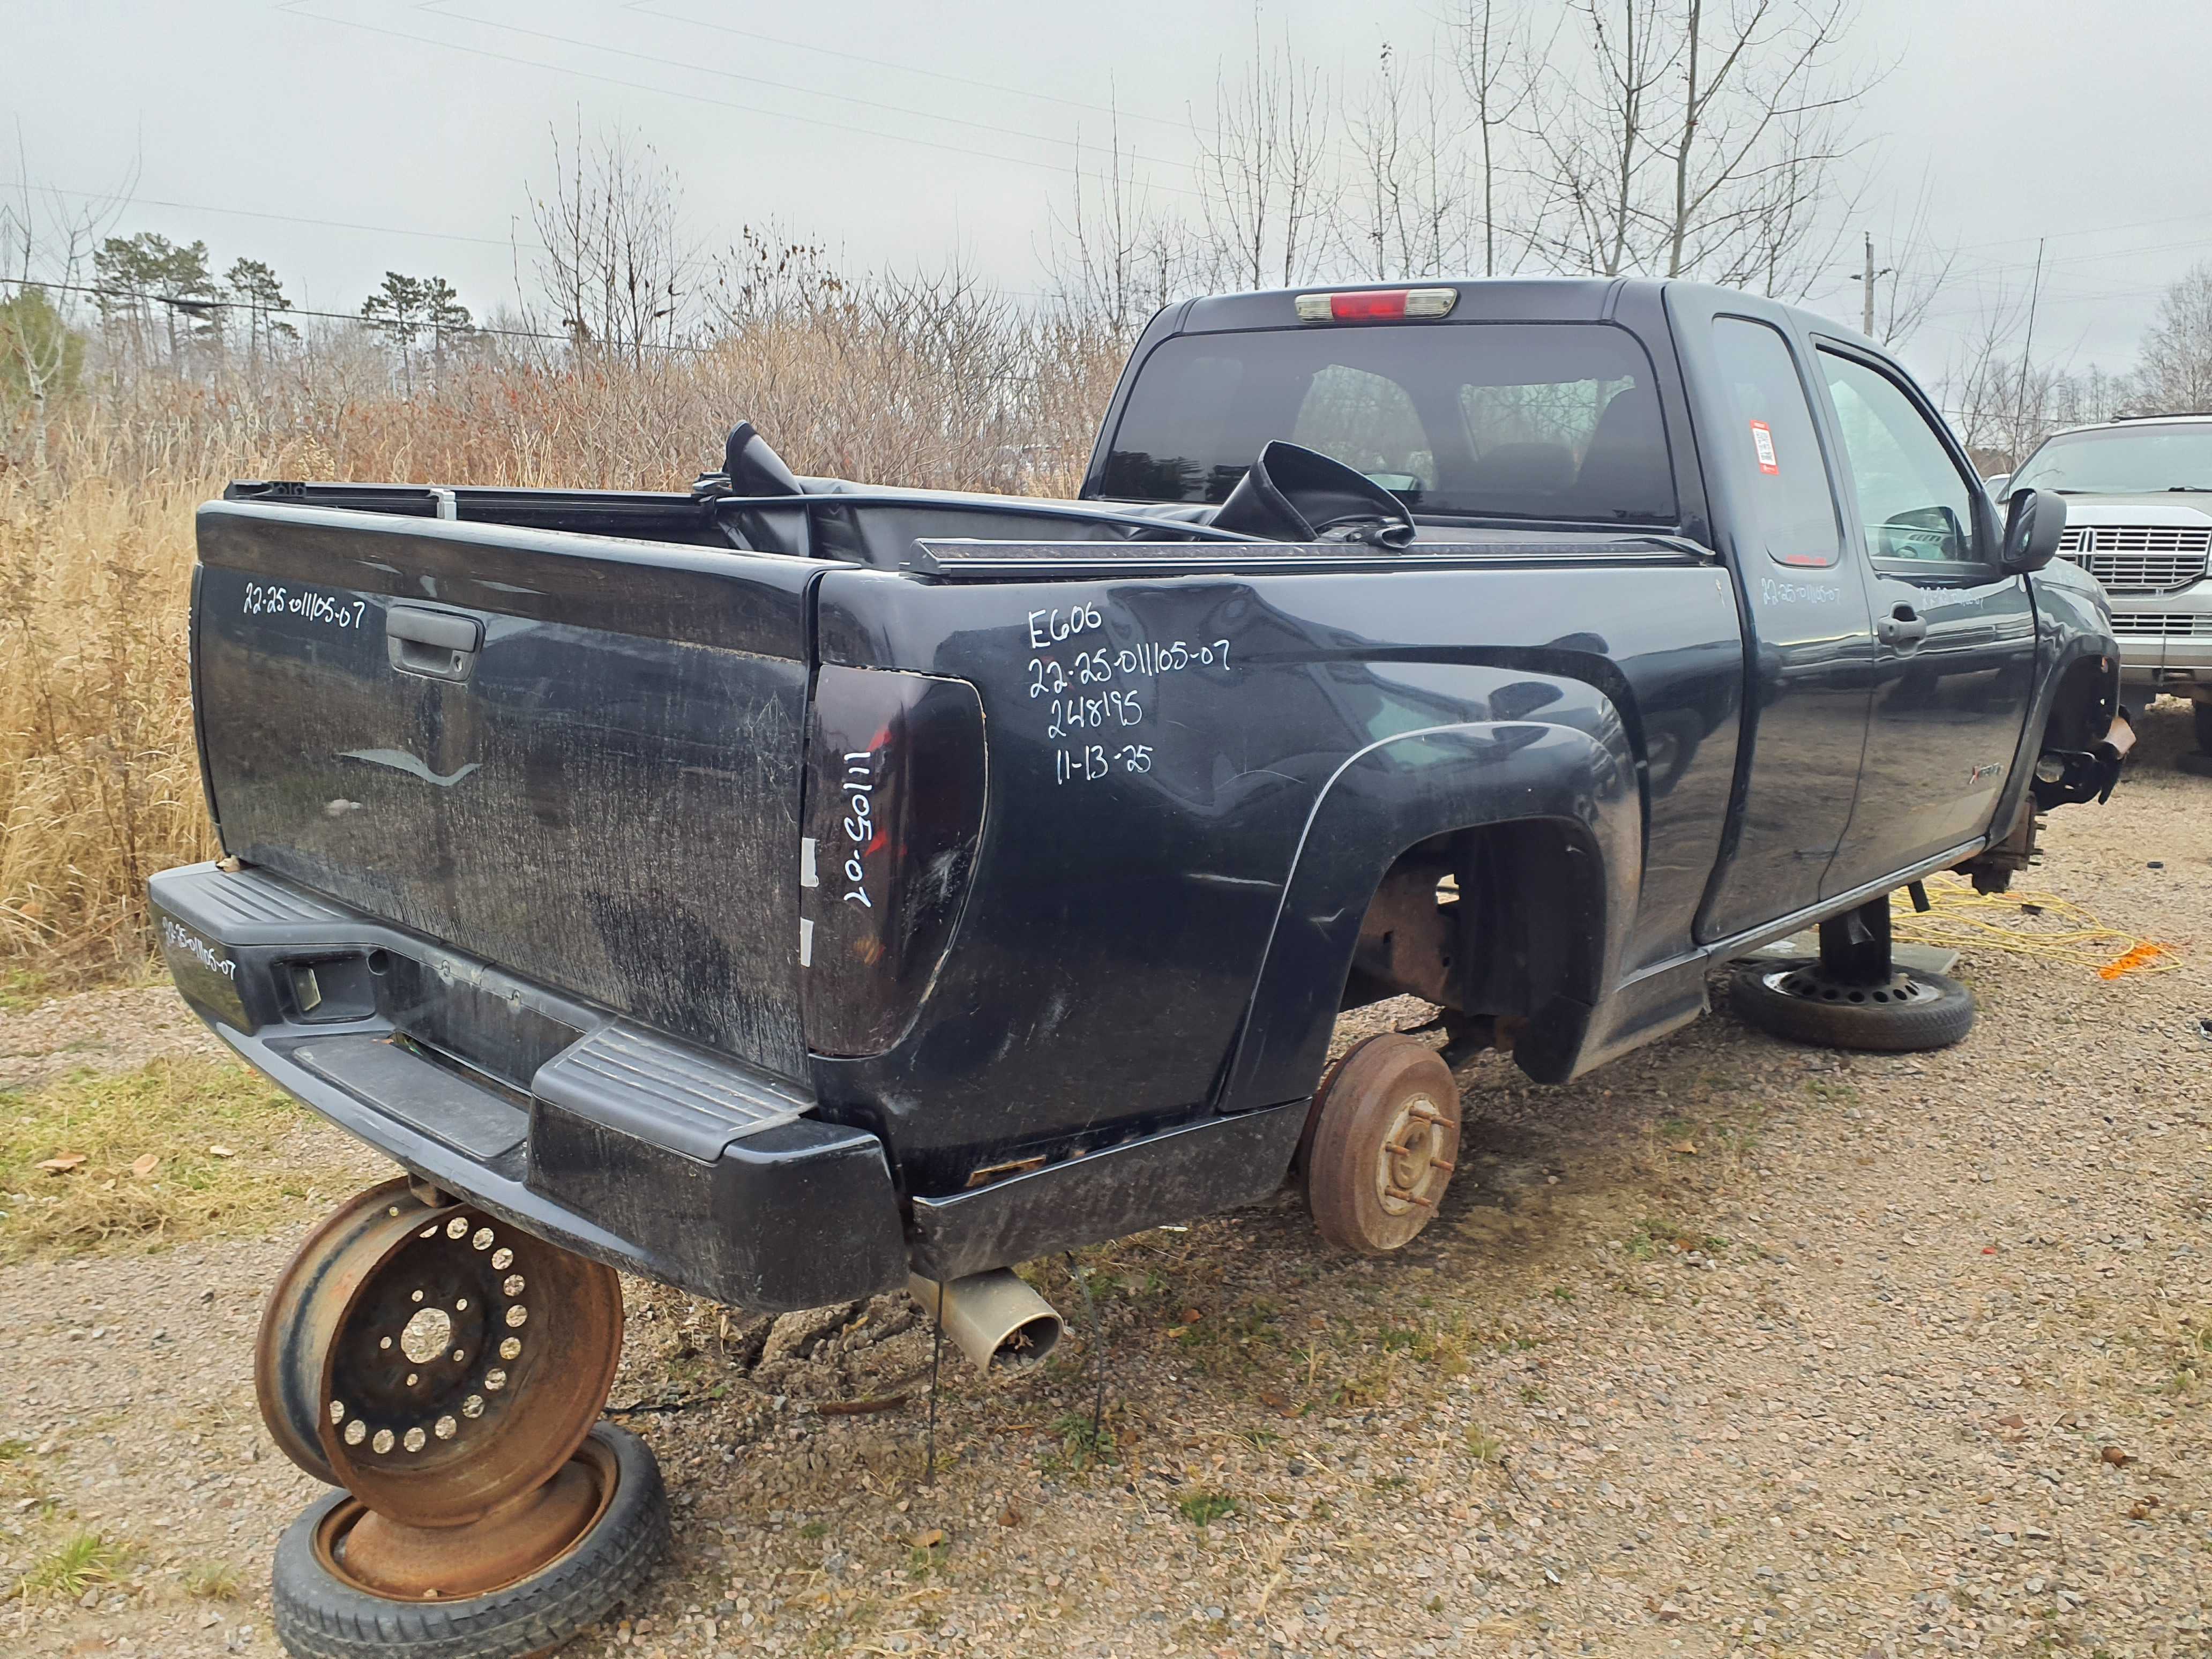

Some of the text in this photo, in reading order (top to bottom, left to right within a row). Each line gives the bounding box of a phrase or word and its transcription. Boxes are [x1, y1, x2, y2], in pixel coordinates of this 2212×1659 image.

[1028, 639, 1231, 698] 22-25-011105-07
[1048, 690, 1142, 738] 248195
[1057, 745, 1153, 784] 11-13-25
[843, 752, 872, 908] 11105-07
